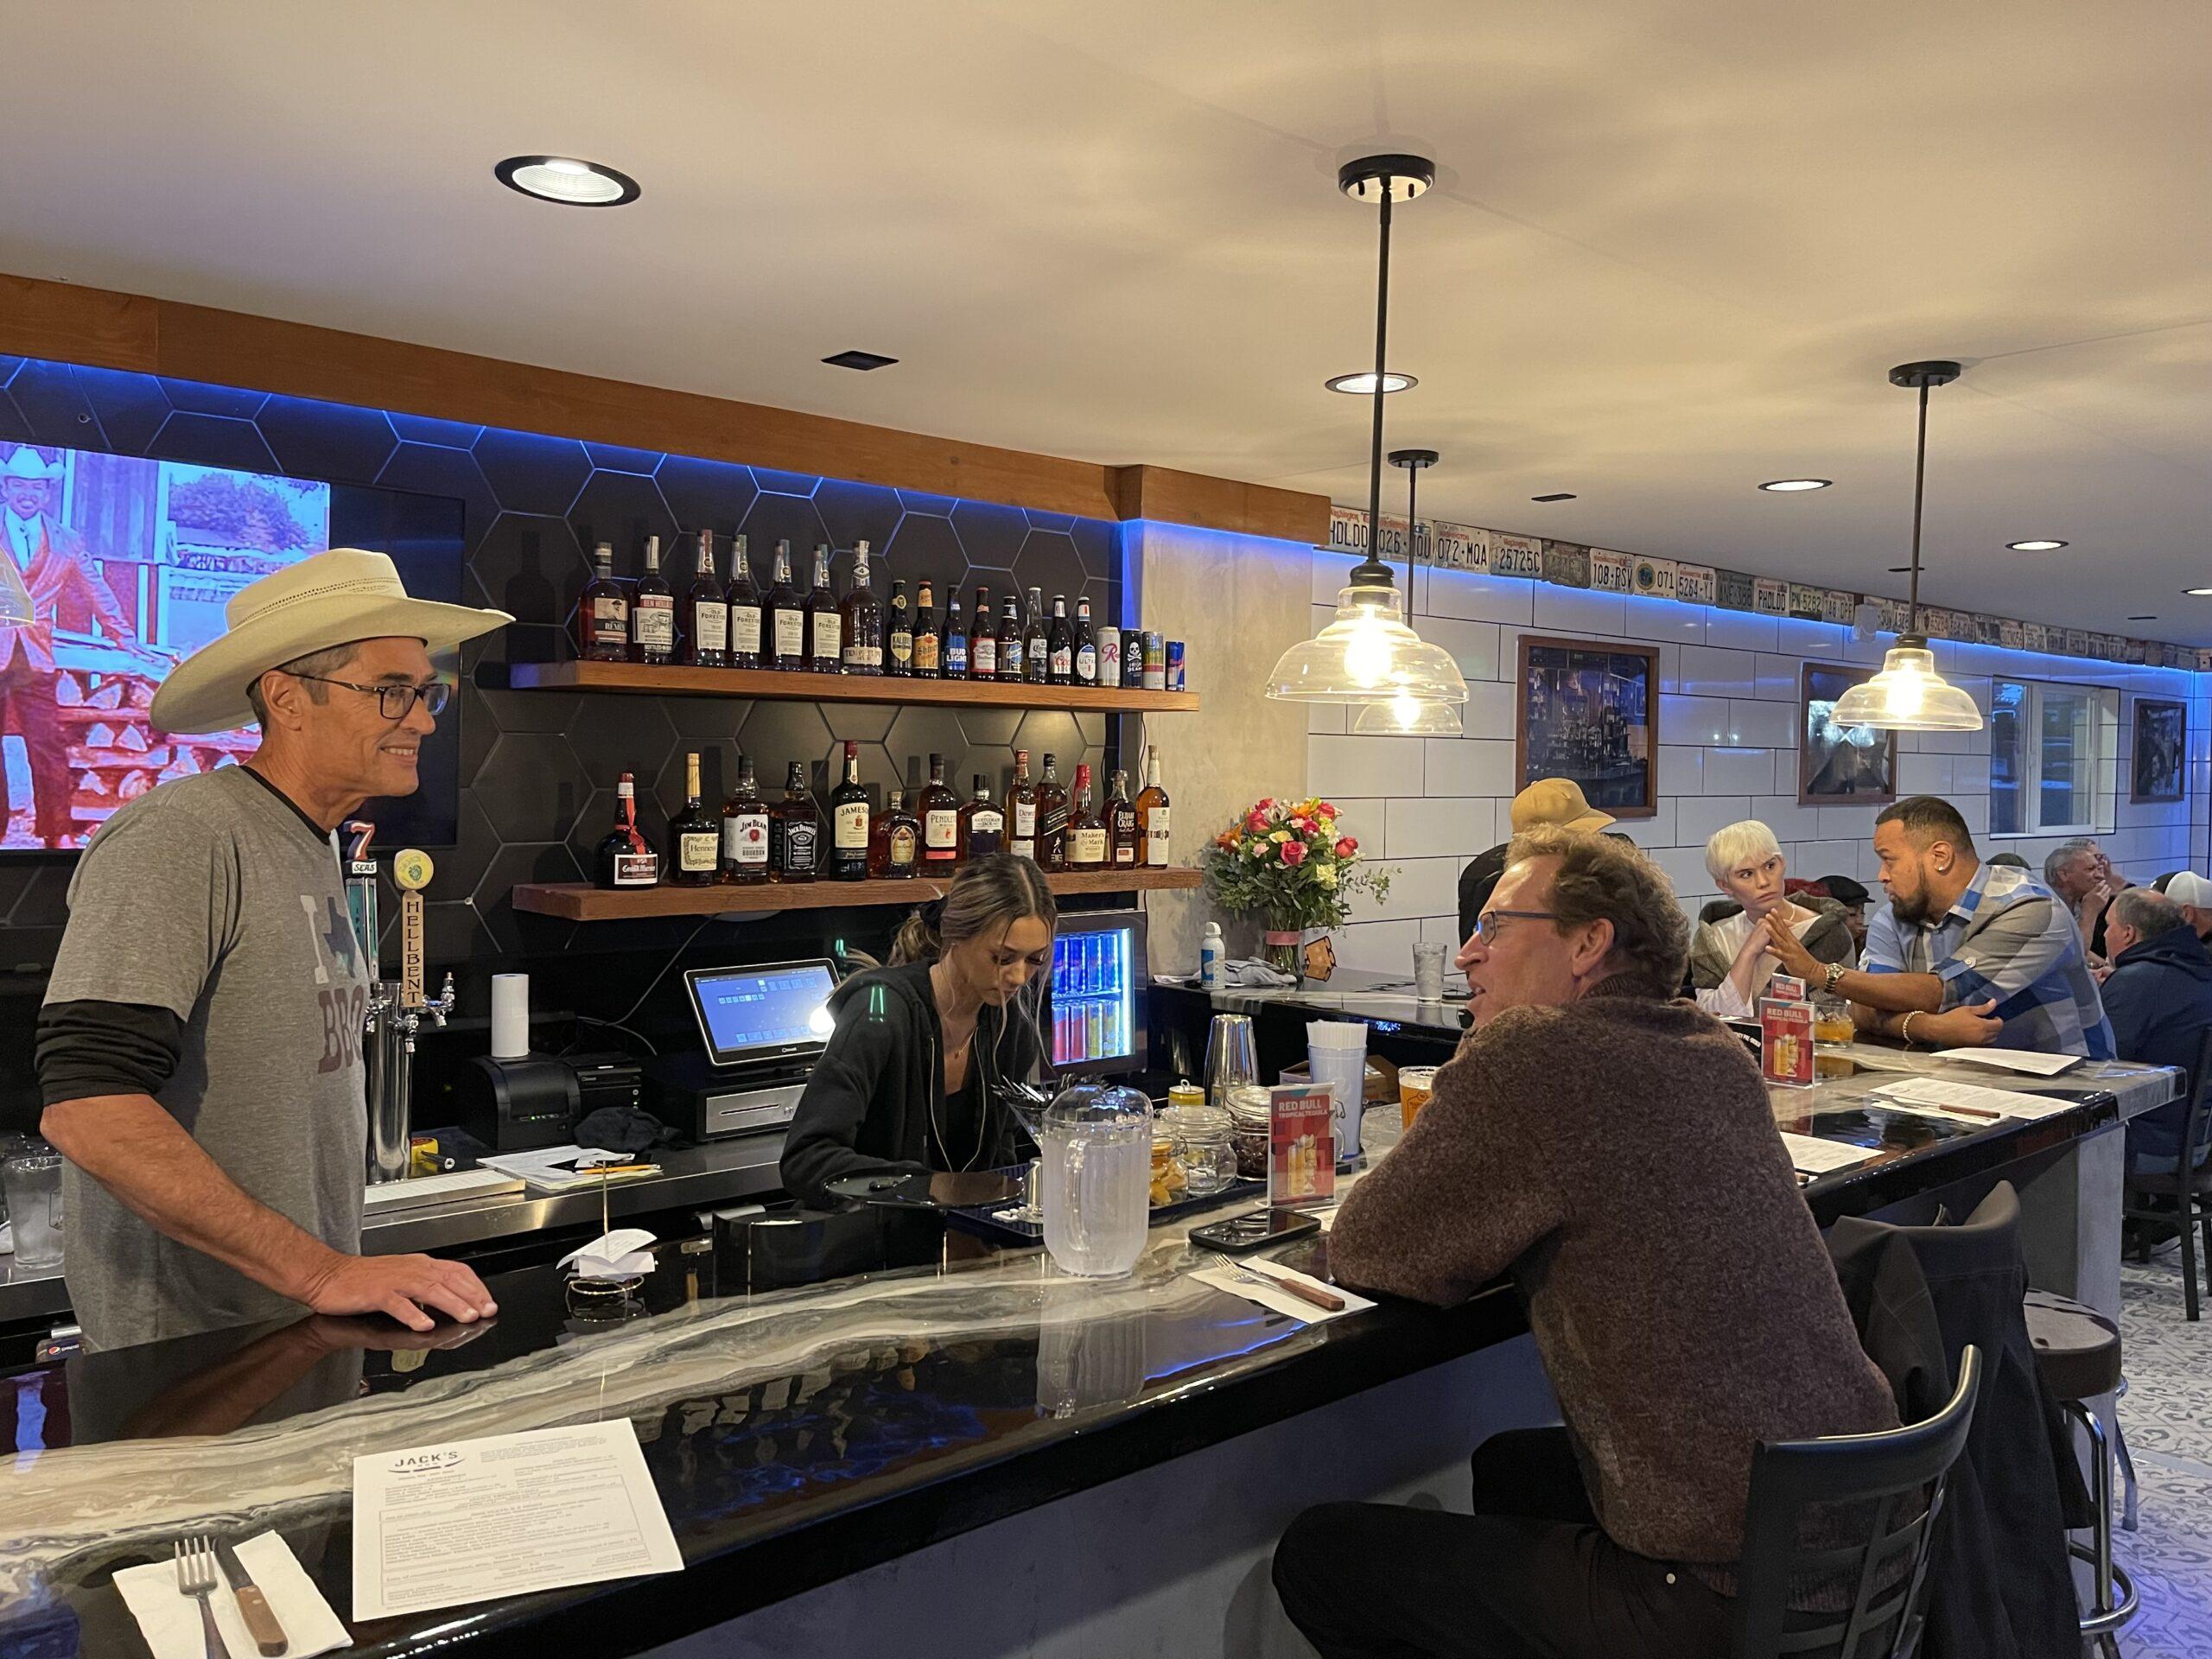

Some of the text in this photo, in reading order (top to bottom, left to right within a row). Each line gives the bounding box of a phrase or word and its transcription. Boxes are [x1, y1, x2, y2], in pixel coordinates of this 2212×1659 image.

[931, 814, 957, 823] PENDLE
[1117, 819, 1135, 828] CRAIG
[740, 822, 752, 833] JIM
[787, 825, 800, 836] JACK
[349, 821, 375, 861] 7
[353, 863, 376, 873] SEAS
[405, 900, 422, 1004] HELLBENT
[1766, 1007, 1803, 1019] RED BULL
[1279, 1098, 1322, 1112] RED BULL
[395, 1451, 458, 1467] JACK'S
